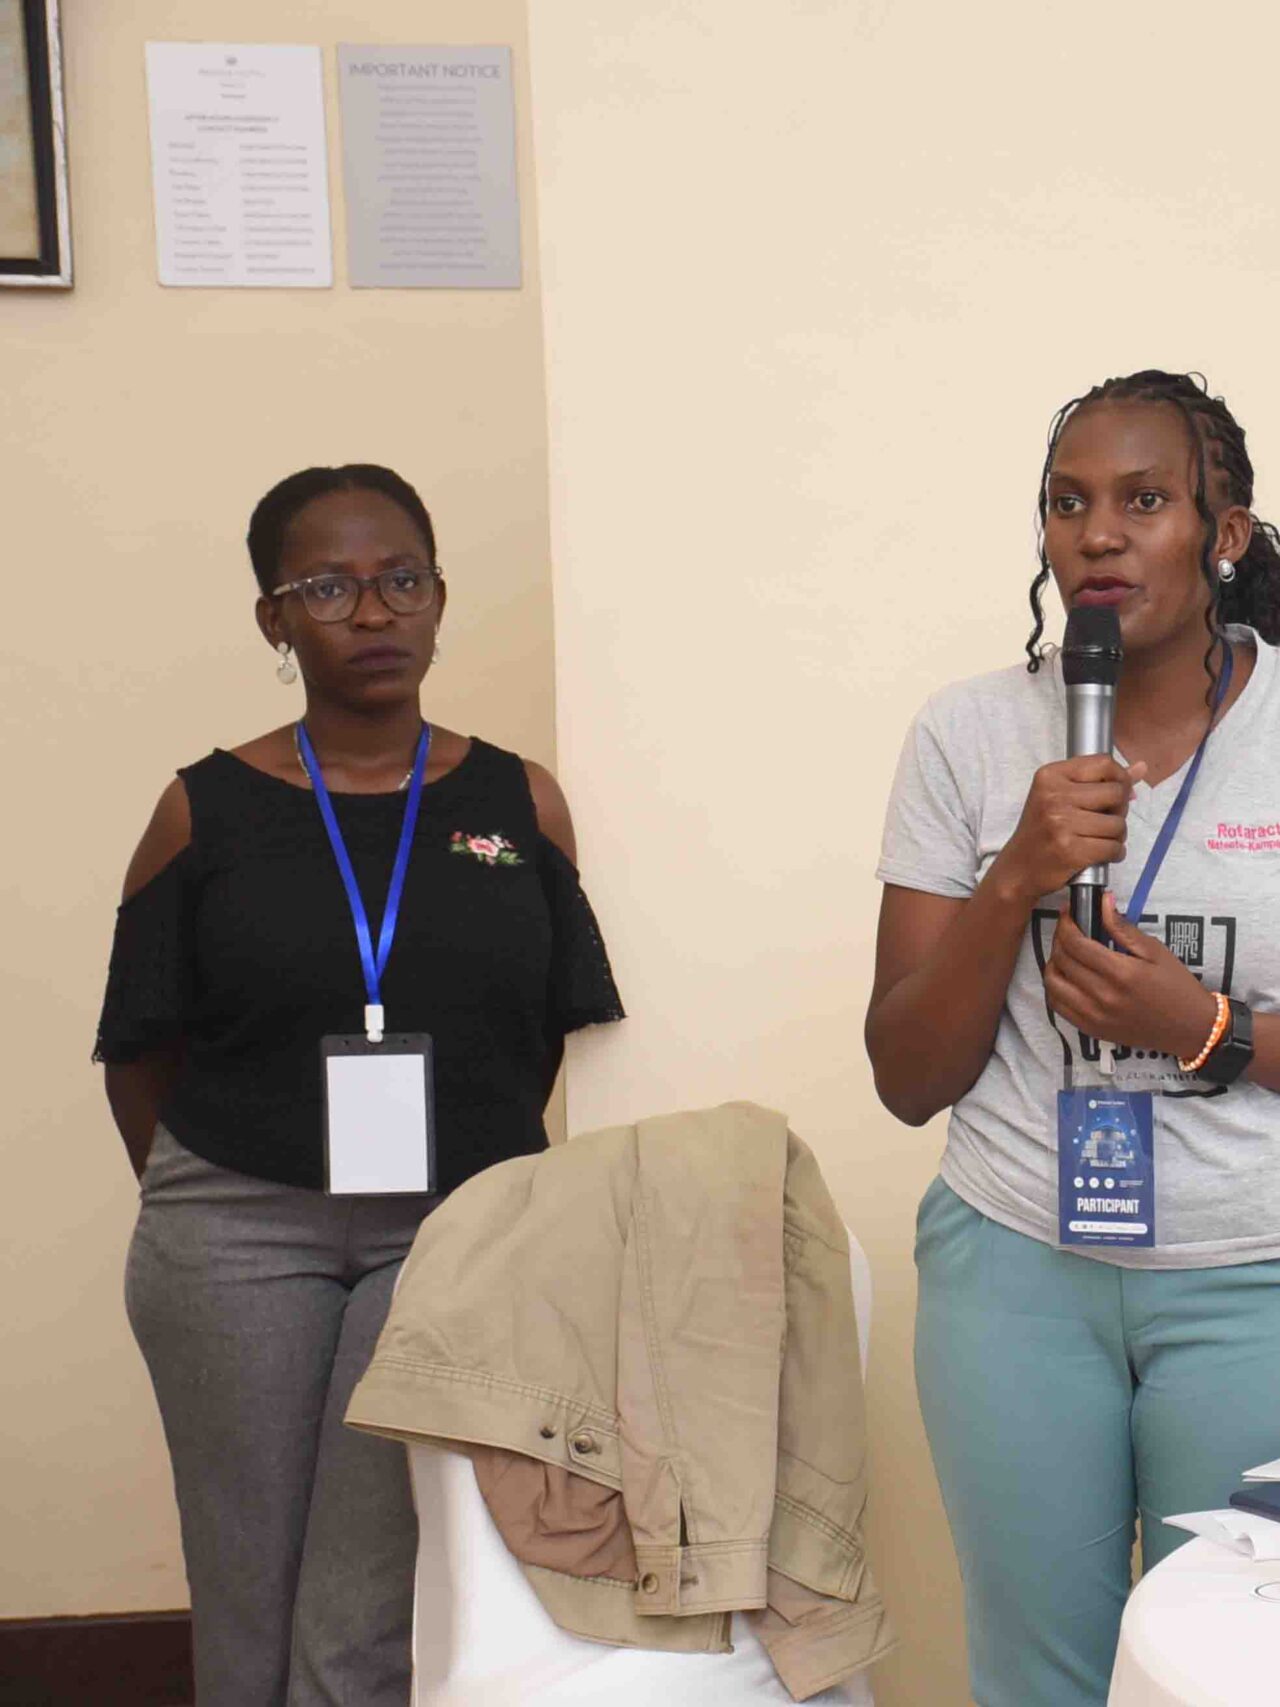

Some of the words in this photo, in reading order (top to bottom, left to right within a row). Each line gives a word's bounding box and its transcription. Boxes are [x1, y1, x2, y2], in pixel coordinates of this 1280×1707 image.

[349, 63, 438, 79] IMPORTANT
[443, 64, 500, 79] NOTICE
[1217, 822, 1280, 839] Rotaract
[1076, 1197, 1140, 1214] PARTICIPANT
